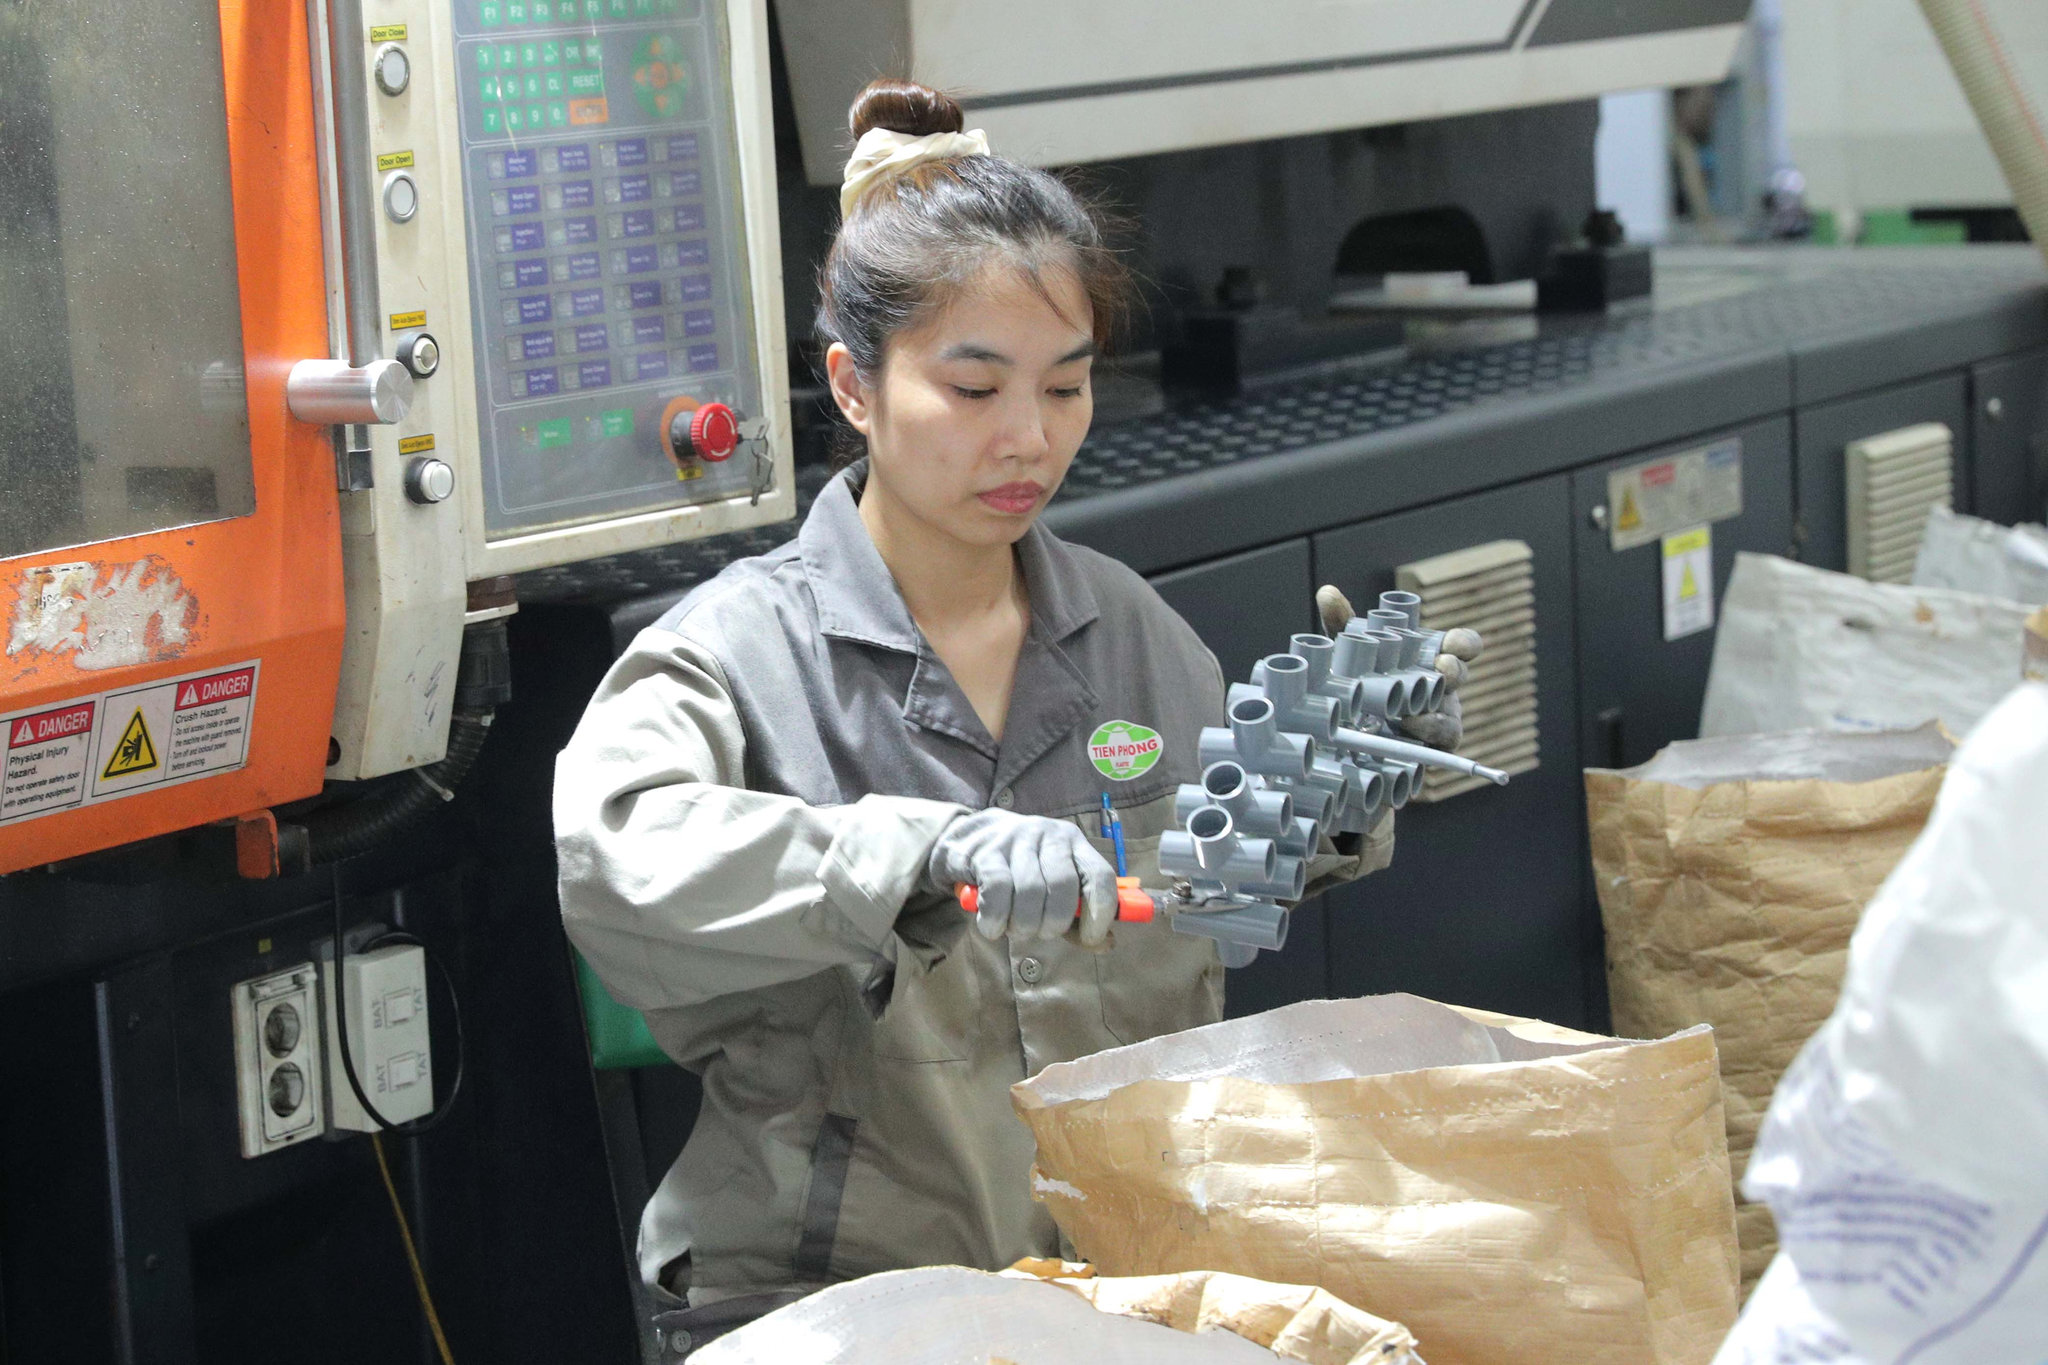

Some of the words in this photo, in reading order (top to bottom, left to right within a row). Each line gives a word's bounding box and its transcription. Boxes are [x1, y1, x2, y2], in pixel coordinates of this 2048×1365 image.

[484, 7, 496, 19] F1
[510, 5, 523, 17] F2
[536, 4, 548, 15] F3
[561, 2, 573, 14] F4
[587, 0, 599, 12] F5
[373, 30, 386, 38] Door
[388, 28, 405, 36] Close
[504, 50, 512, 63] 2
[526, 49, 534, 61] 3
[486, 82, 493, 95] 4
[507, 81, 515, 94] 5
[529, 79, 536, 92] 6
[549, 79, 560, 90] CL
[572, 74, 600, 87] RESET
[488, 113, 495, 125] 7
[510, 112, 518, 124] 8
[532, 110, 539, 122] 9
[380, 158, 393, 166] Door
[396, 155, 411, 165] Open
[202, 675, 249, 700] DANGER
[175, 712, 198, 723] Crush
[200, 706, 228, 719] Hazard.
[38, 711, 89, 738] DANGER
[183, 736, 200, 744] machine
[1092, 745, 1115, 758] TIEN
[1118, 739, 1158, 756] PHONG
[9, 750, 44, 766] Physical
[46, 746, 69, 758] Injury
[8, 765, 38, 780] Hazard.
[6, 786, 14, 795] Do
[15, 784, 25, 792] not
[26, 779, 47, 790] operate
[48, 774, 65, 785] safety
[66, 771, 80, 780] door
[4, 800, 16, 808] with
[17, 793, 44, 805] operating
